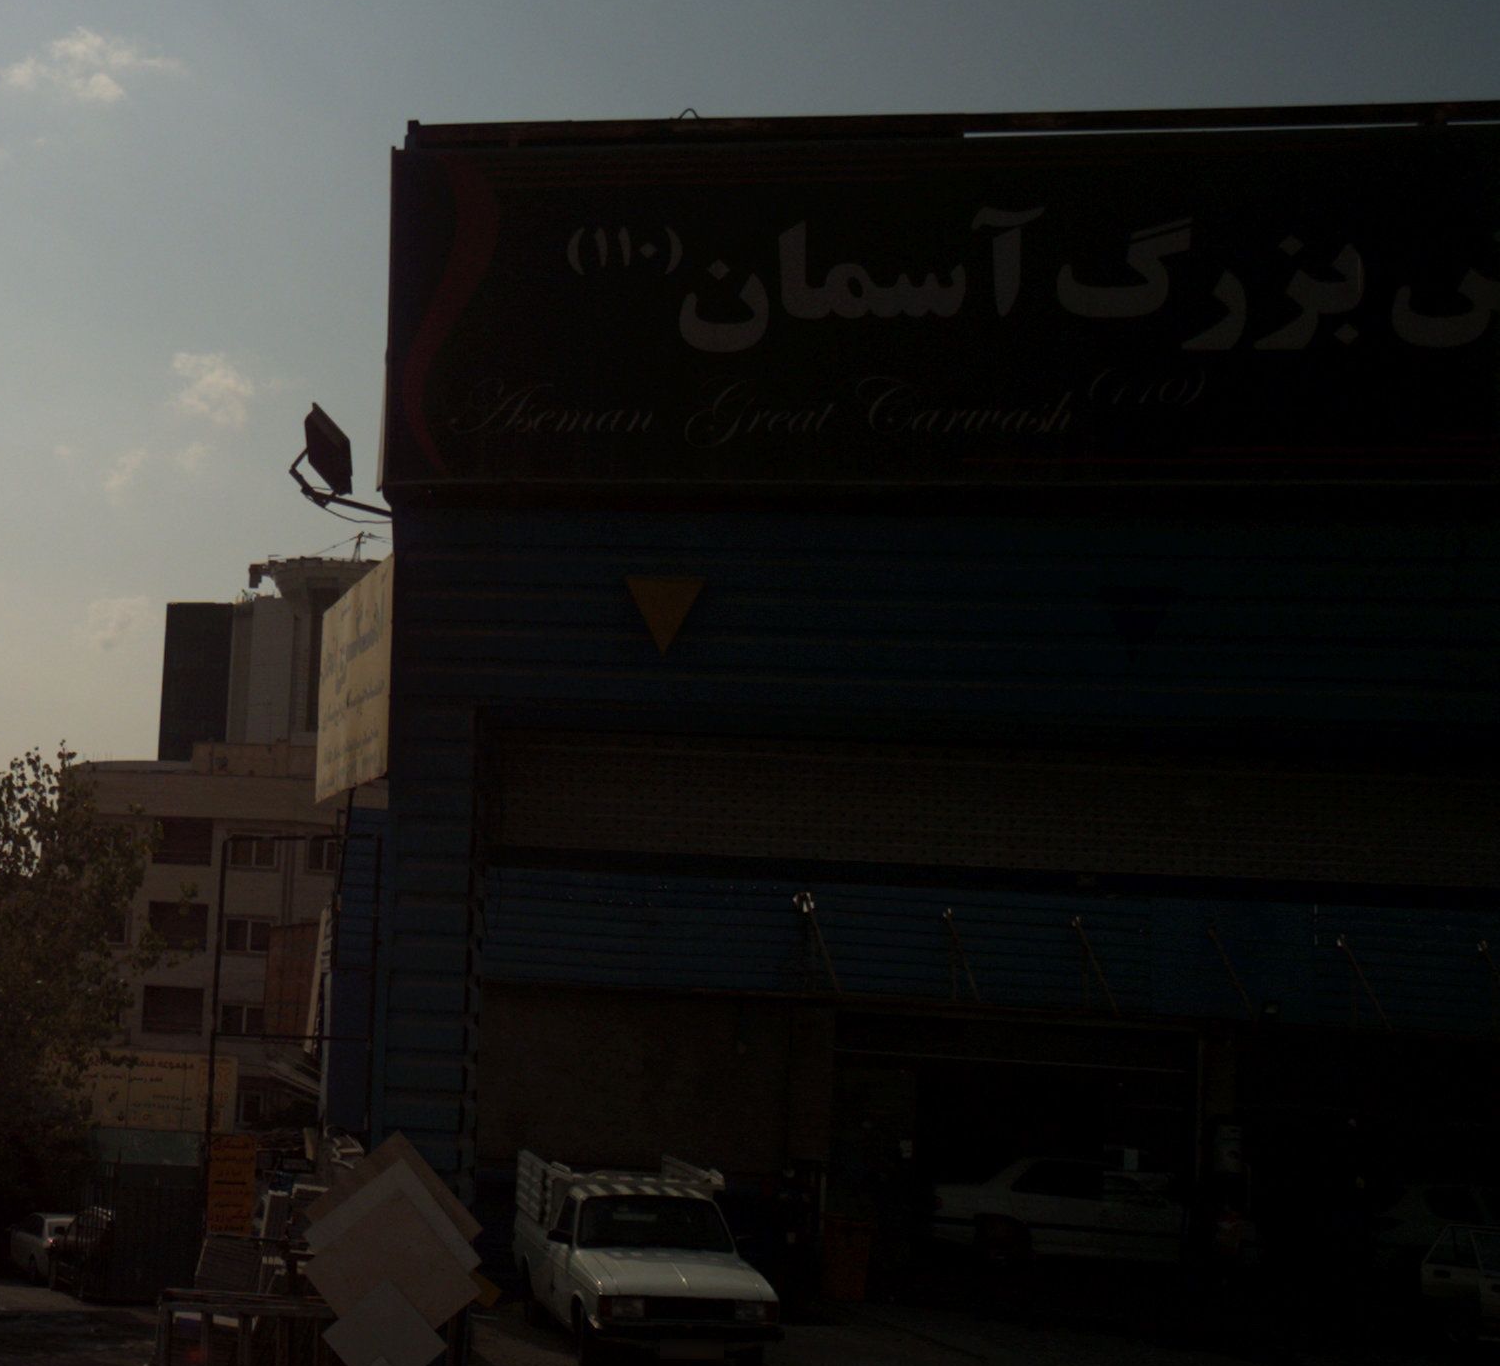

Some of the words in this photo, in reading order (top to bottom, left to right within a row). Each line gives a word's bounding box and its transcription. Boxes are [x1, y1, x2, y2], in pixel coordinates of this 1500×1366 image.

[678, 205, 1045, 354] آسمان
[1056, 216, 1365, 352] بزرگ
[449, 377, 654, 435] Aseman
[684, 377, 836, 449] Great
[855, 375, 1076, 434] Carwash
